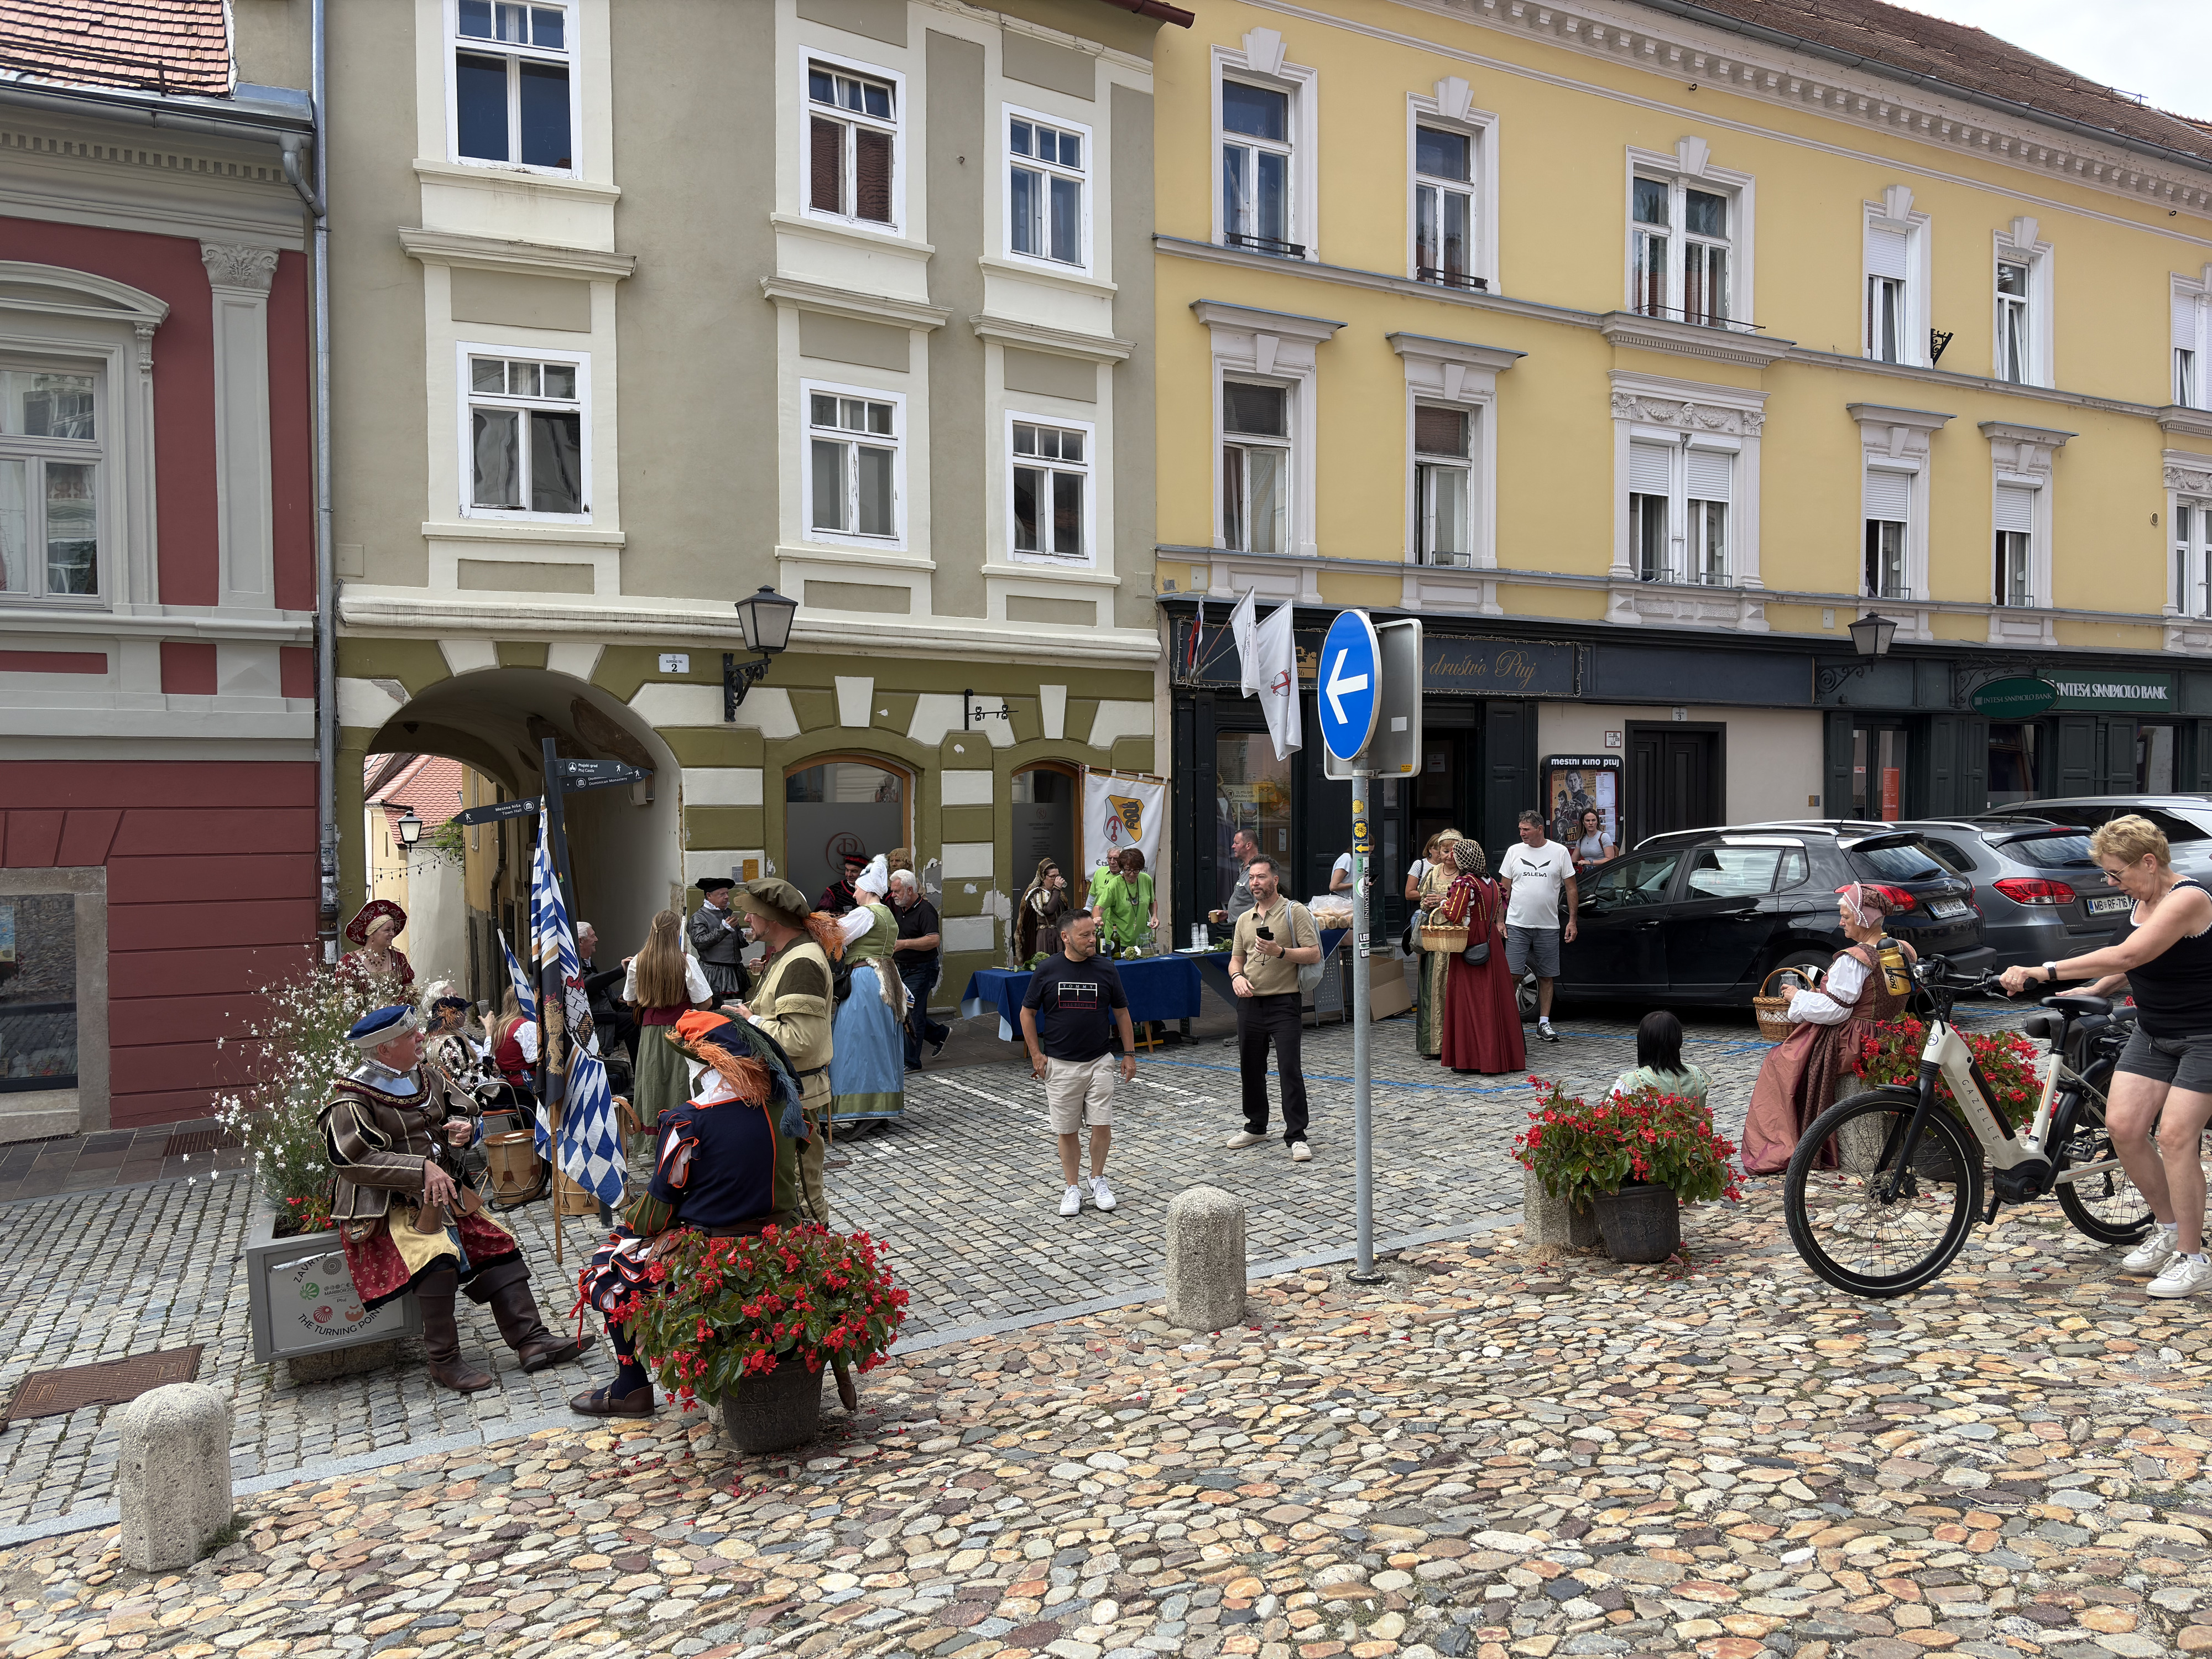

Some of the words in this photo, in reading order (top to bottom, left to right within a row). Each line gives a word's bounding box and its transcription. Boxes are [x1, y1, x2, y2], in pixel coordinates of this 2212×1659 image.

[671, 664, 677, 672] 2
[1430, 654, 1488, 676] društvo
[1495, 650, 1537, 690] Ptuj
[2056, 682, 2092, 697] INTESA
[2092, 684, 2140, 698] SANPAOLO
[2141, 685, 2169, 700] BANK
[2004, 694, 2034, 702] SANPAOLO
[1603, 759, 1620, 767] ptuj
[1933, 902, 1945, 913] MB
[2093, 900, 2104, 911] MB
[2107, 898, 2128, 910] RF-716
[1962, 1079, 2000, 1141] GAZELLE
[298, 1313, 315, 1329] THE
[314, 1324, 357, 1336] TURNING
